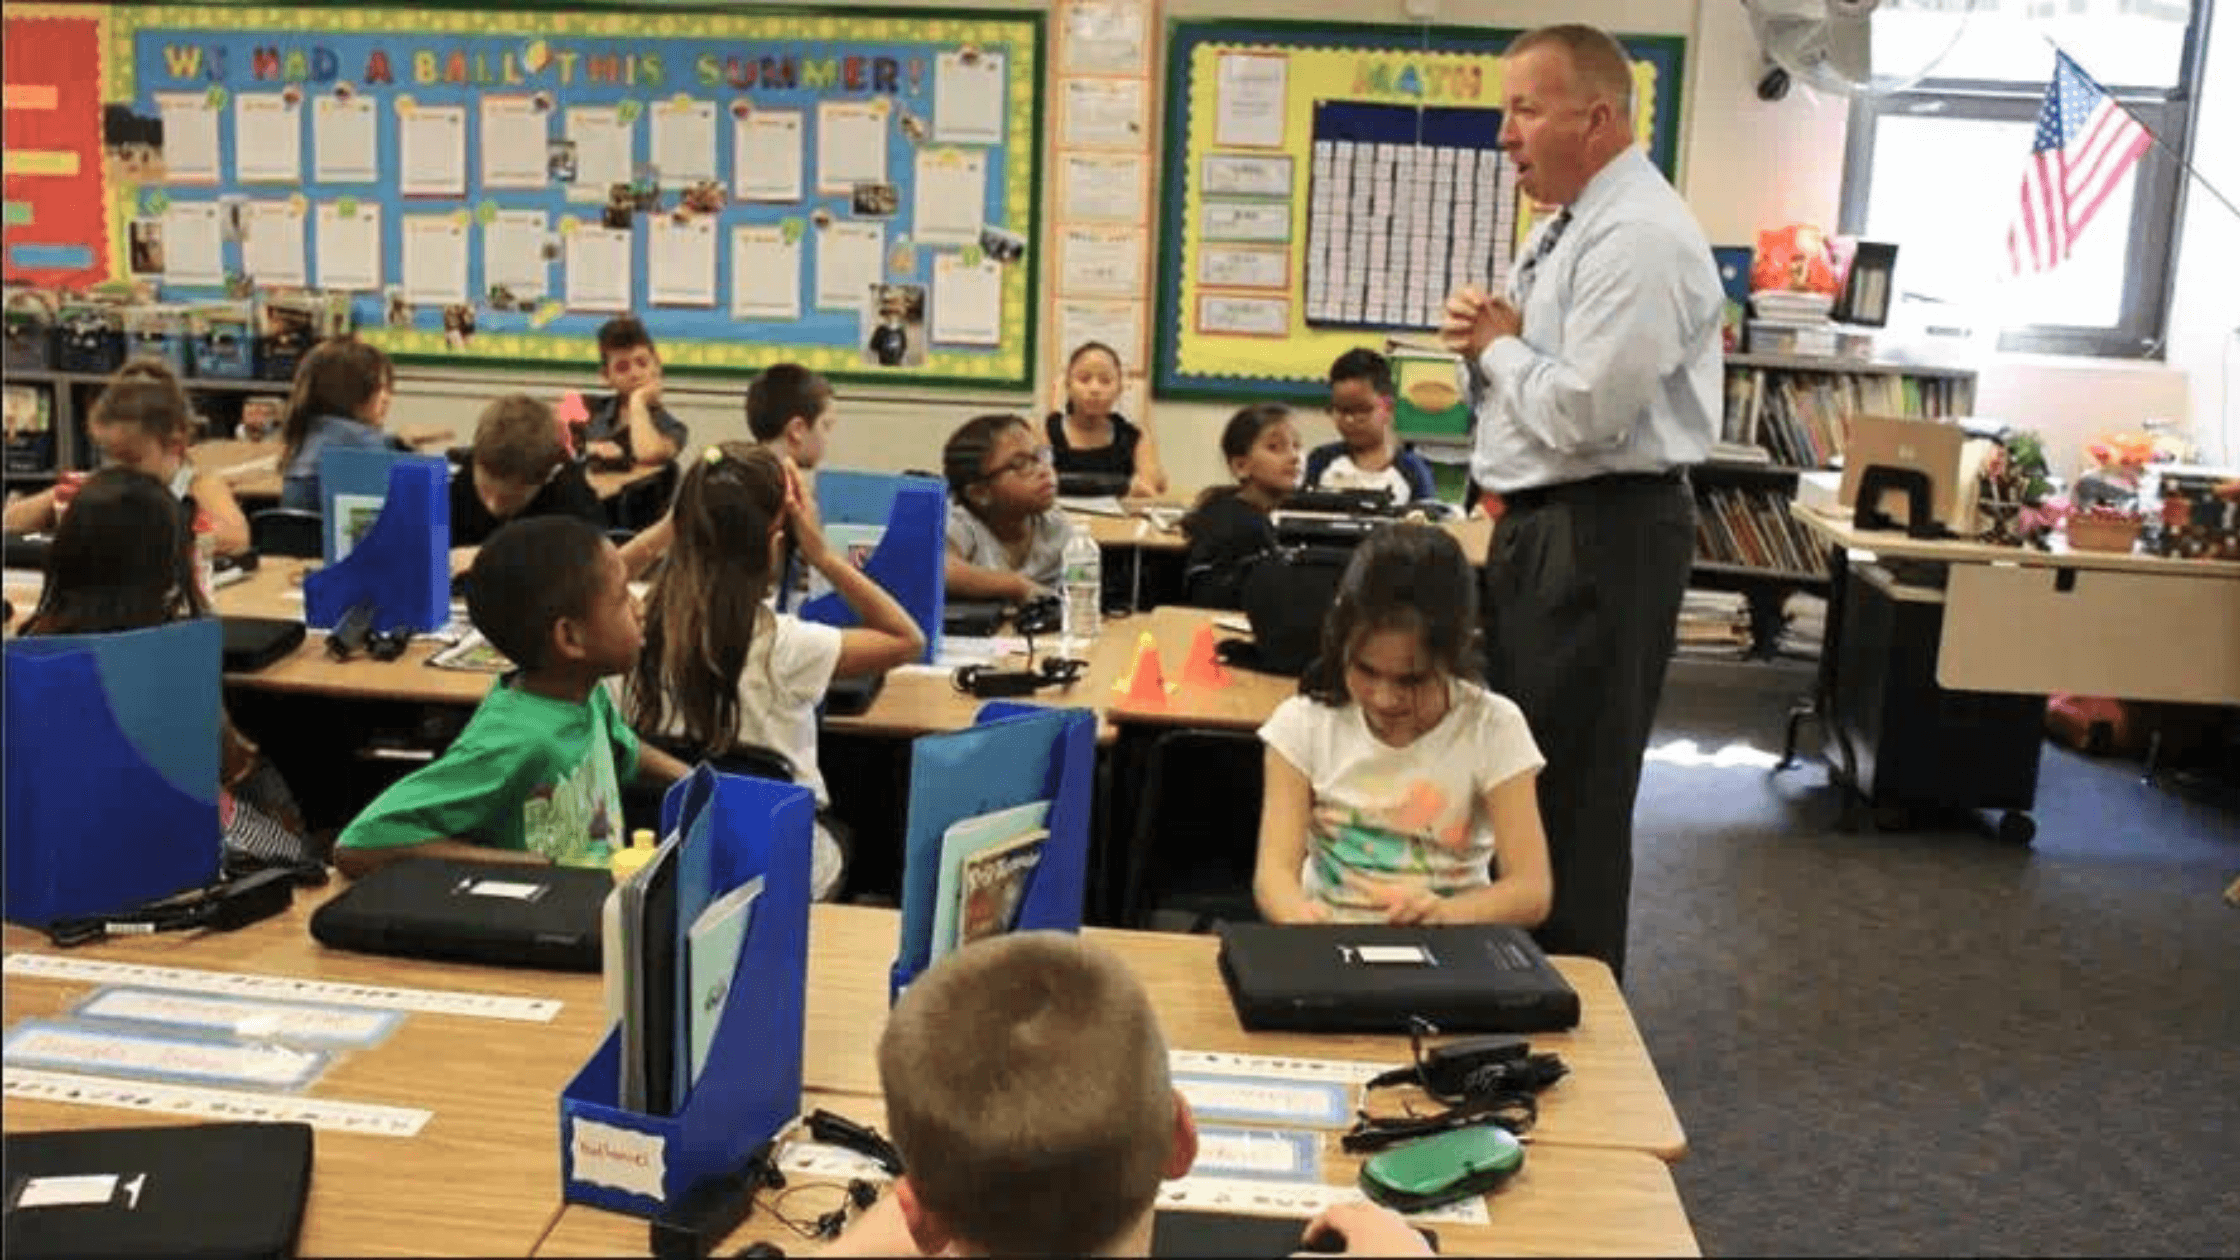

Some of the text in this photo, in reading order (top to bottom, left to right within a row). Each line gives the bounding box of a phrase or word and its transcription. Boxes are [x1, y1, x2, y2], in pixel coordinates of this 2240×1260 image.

[163, 45, 923, 96] WE HAD A BALL THIS SUMMER!
[1352, 60, 1484, 99] MATH
